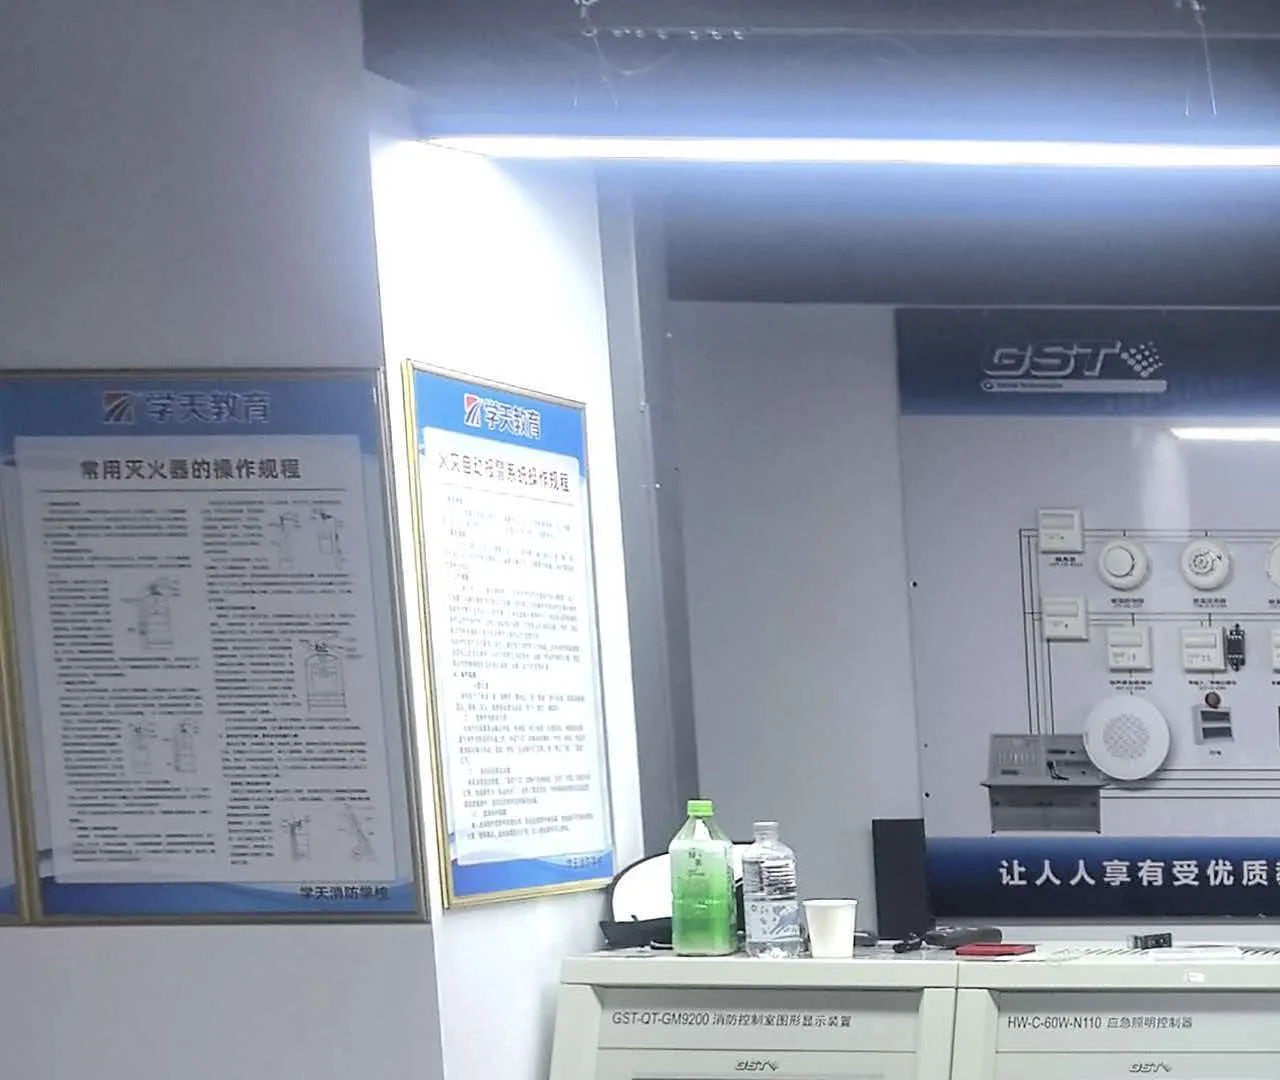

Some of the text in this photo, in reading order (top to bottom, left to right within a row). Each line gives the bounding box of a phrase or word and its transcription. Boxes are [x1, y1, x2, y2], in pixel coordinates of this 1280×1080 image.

[982, 338, 1122, 377] GST
[146, 390, 270, 424] 学天教育
[483, 398, 541, 440] 学天教育
[80, 457, 301, 480] 常用灭火器的操作规程
[612, 1011, 851, 1028] GST-QT-GM9200 消防控制室图形显示装置
[1007, 1016, 1102, 1029] HW-C-60W-N110
